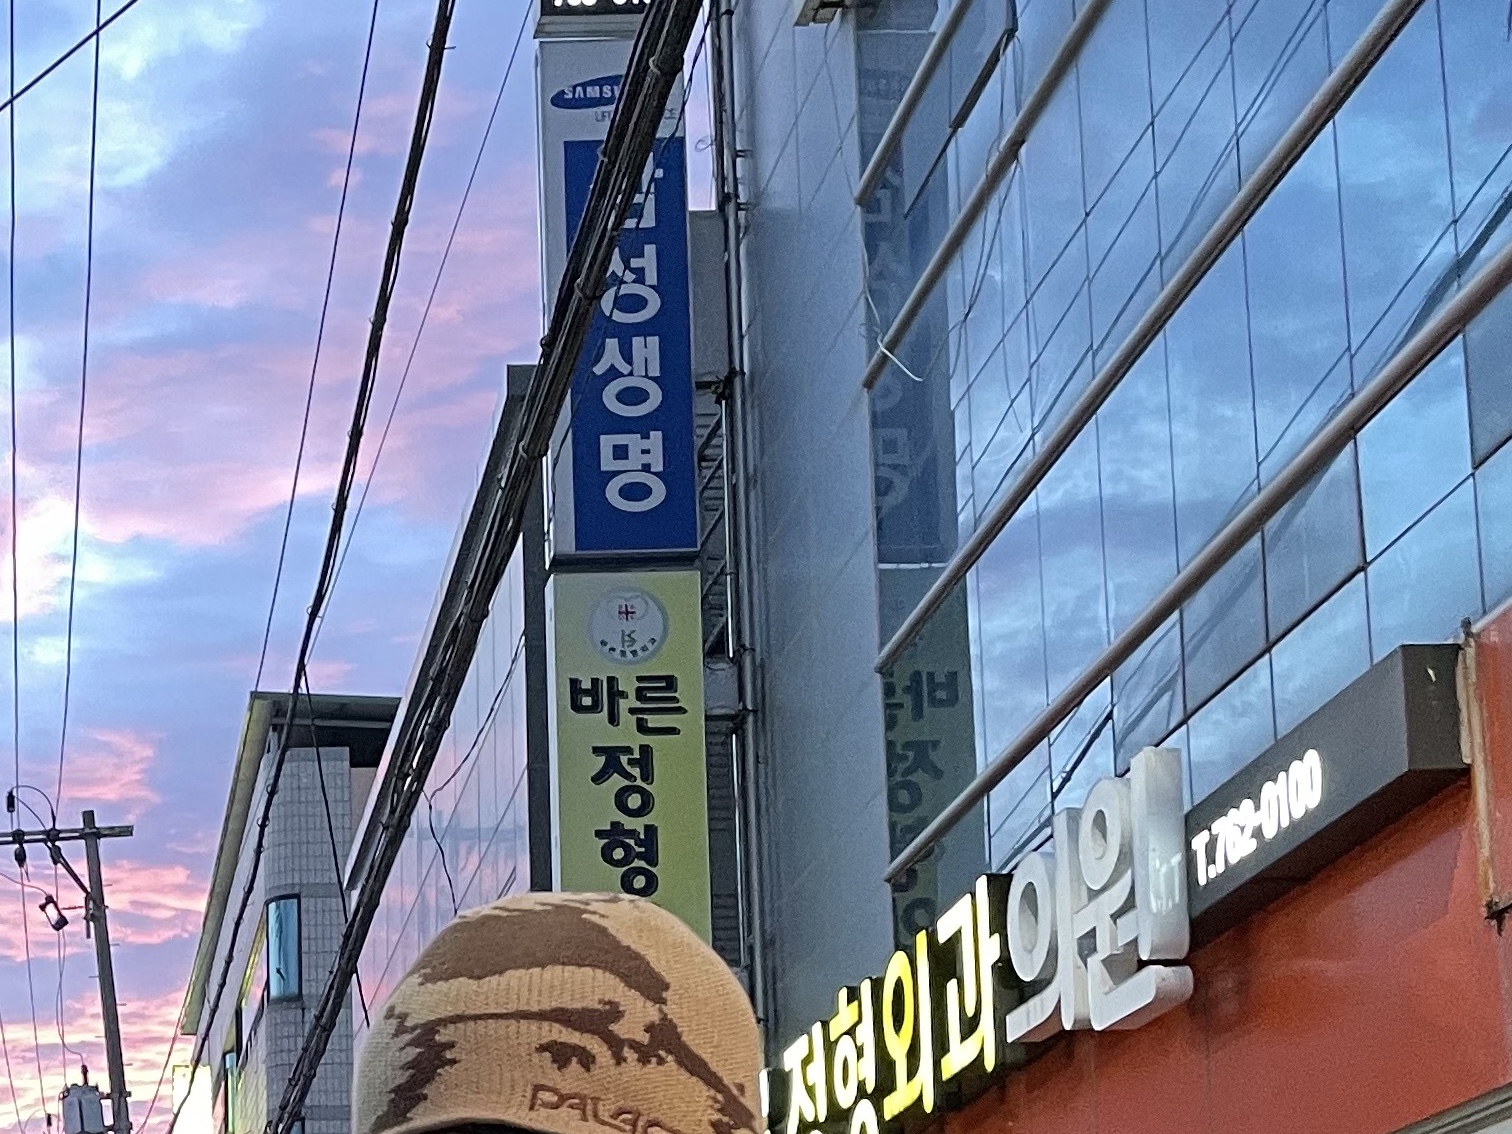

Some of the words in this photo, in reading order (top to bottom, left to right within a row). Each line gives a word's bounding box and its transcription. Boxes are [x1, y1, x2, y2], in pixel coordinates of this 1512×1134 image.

[568, 674, 688, 736] 바른
[590, 743, 659, 897] 정형
[1191, 748, 1323, 887] T.762-0100
